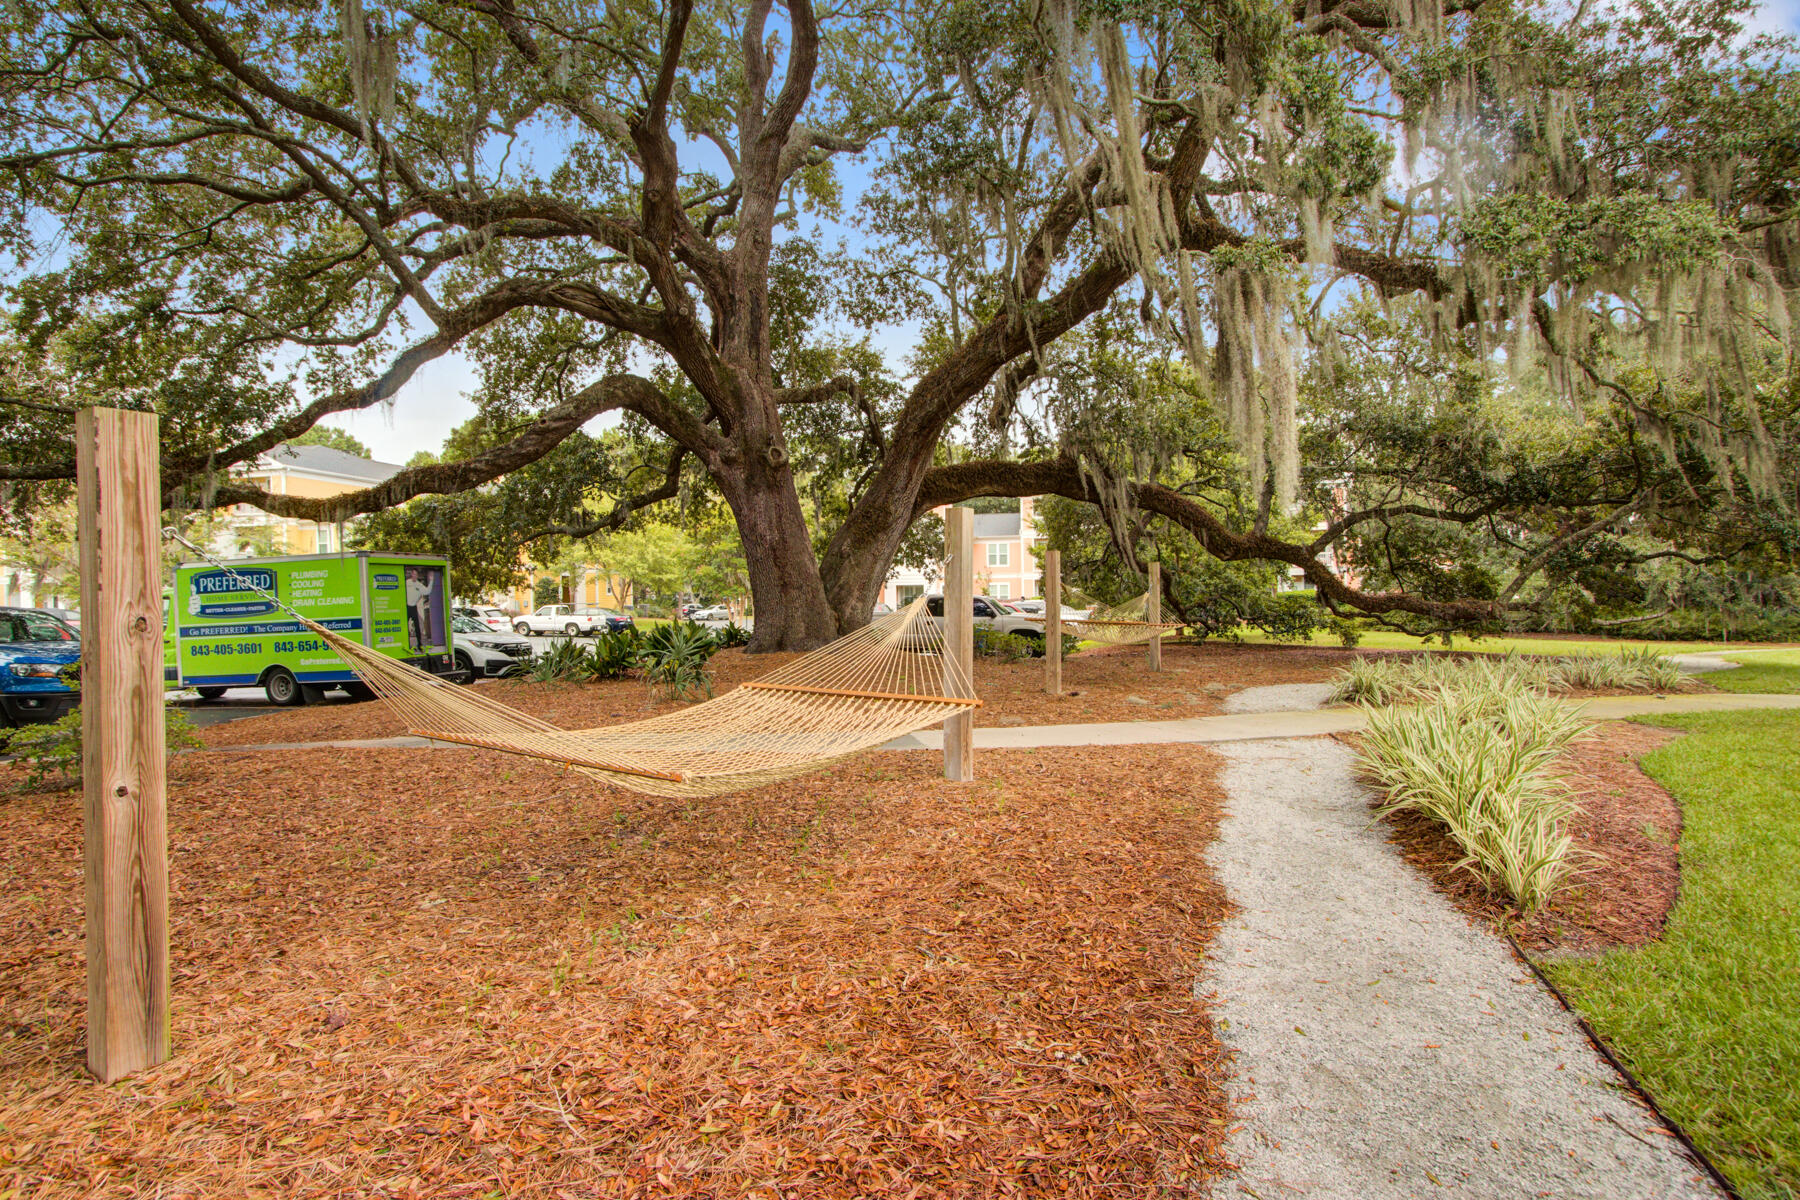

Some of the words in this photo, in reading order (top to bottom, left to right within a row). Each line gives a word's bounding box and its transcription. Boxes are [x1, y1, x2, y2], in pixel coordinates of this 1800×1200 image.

[291, 570, 328, 579] PLUMBING
[199, 574, 270, 592] PREFERRED
[291, 579, 325, 589] COOLING
[292, 589, 323, 598] HEATING
[292, 599, 315, 607] DRAIN
[317, 596, 354, 605] CLEANING
[189, 628, 200, 636] Go
[200, 626, 249, 635] PREFERRED!
[253, 625, 266, 633] The
[267, 623, 298, 633] Company
[323, 620, 352, 630] Referred
[191, 643, 262, 656] 843-405-3601
